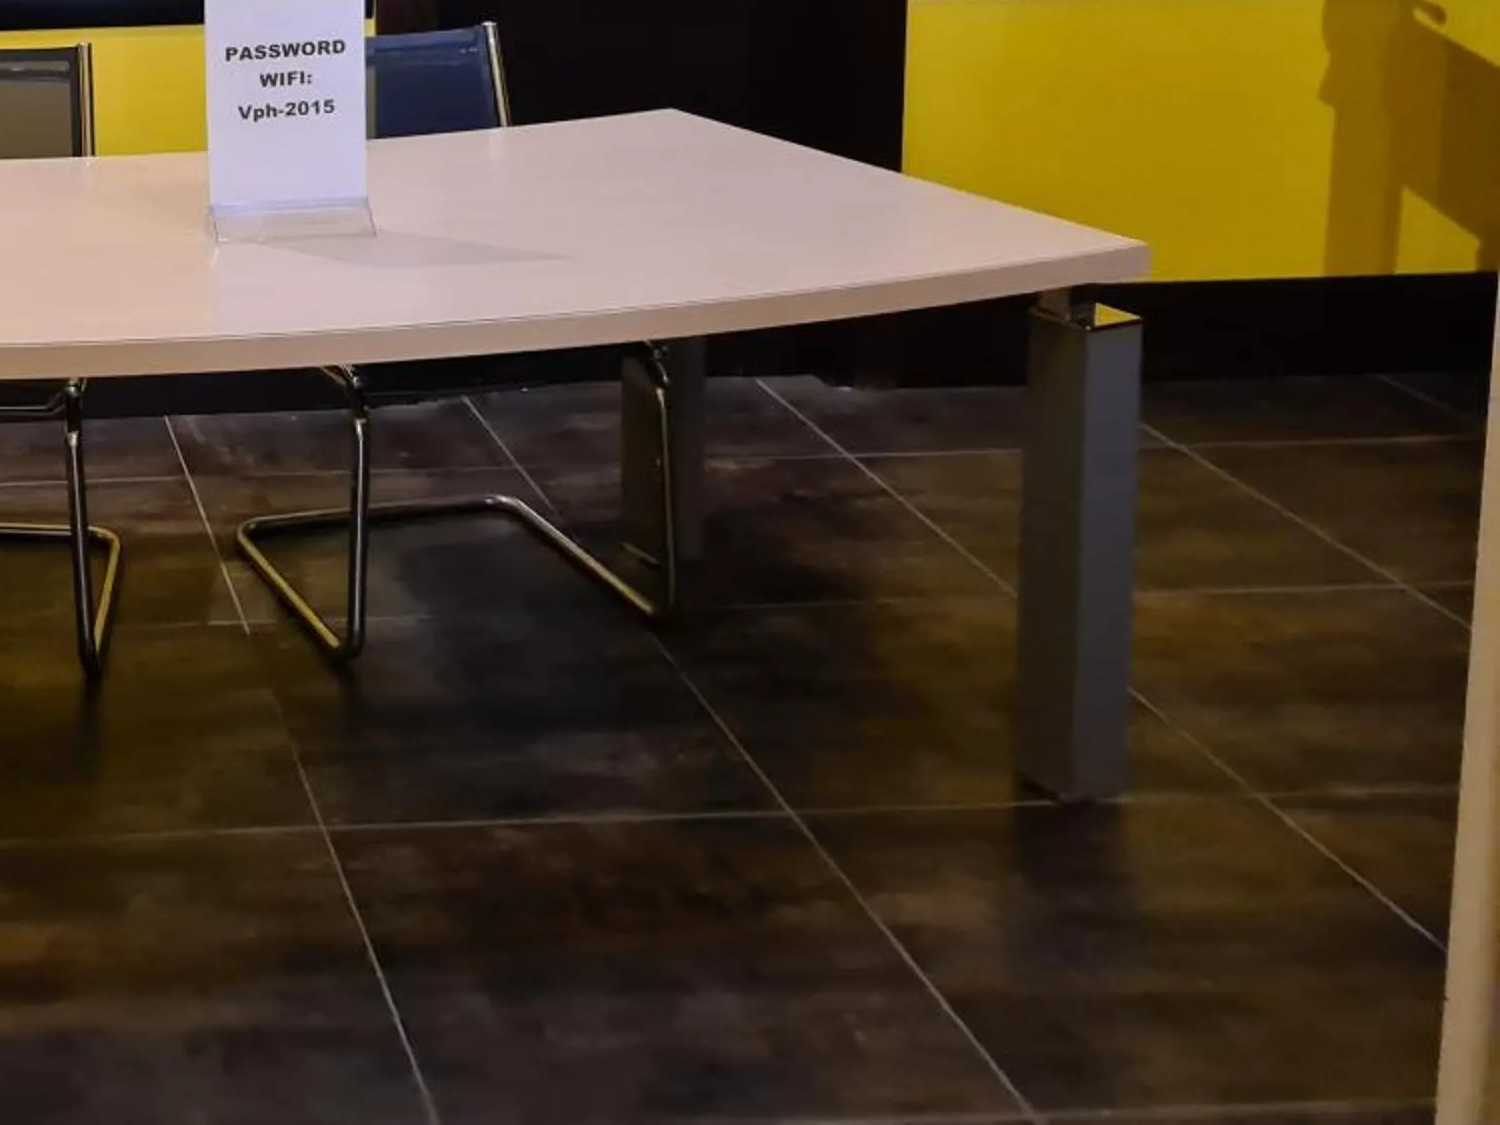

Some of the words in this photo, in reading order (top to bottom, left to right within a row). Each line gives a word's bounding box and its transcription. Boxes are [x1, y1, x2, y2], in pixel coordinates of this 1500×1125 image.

[225, 39, 346, 62] PASSWORD
[259, 71, 312, 88] WIFI:
[238, 99, 335, 122] Vph-2015
